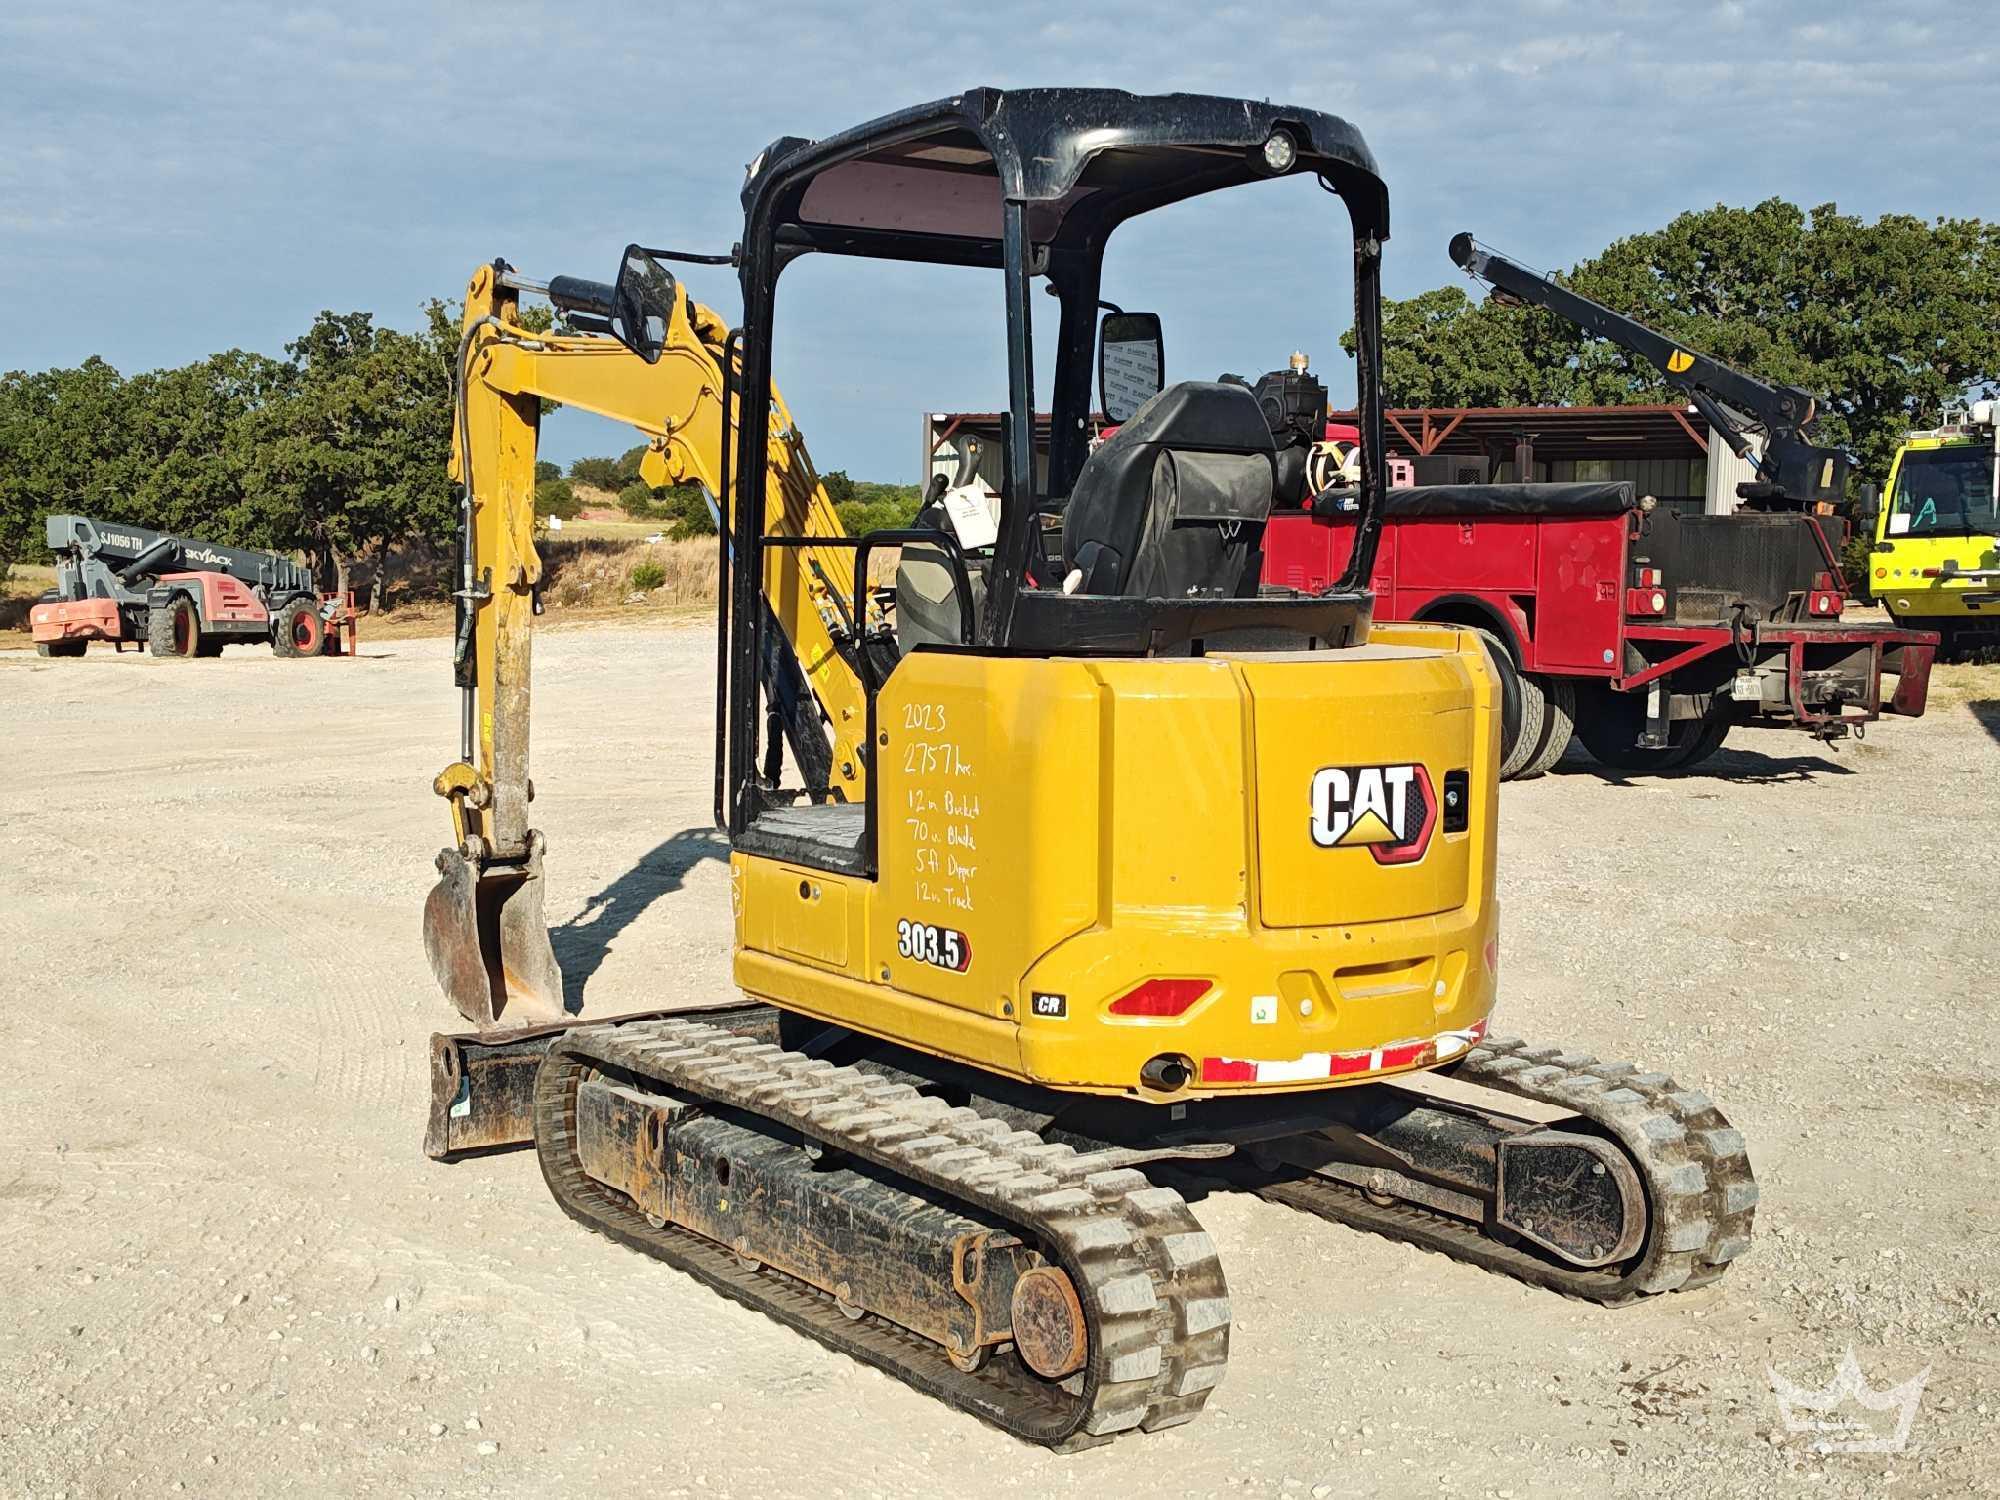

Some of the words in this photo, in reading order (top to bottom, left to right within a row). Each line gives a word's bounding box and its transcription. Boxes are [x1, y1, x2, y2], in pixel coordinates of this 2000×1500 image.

[100, 531, 130, 551] SJ1056
[131, 536, 143, 551] TH
[184, 547, 233, 567] SKYJACK
[902, 703, 946, 732] 2023
[903, 742, 952, 775] 2757
[908, 789, 926, 813] 12
[1312, 765, 1414, 845] CAT
[905, 818, 928, 841] 70
[915, 848, 928, 873] 5
[915, 879, 931, 902] 12
[897, 919, 960, 968] 303.5
[1038, 996, 1061, 1014] CR
